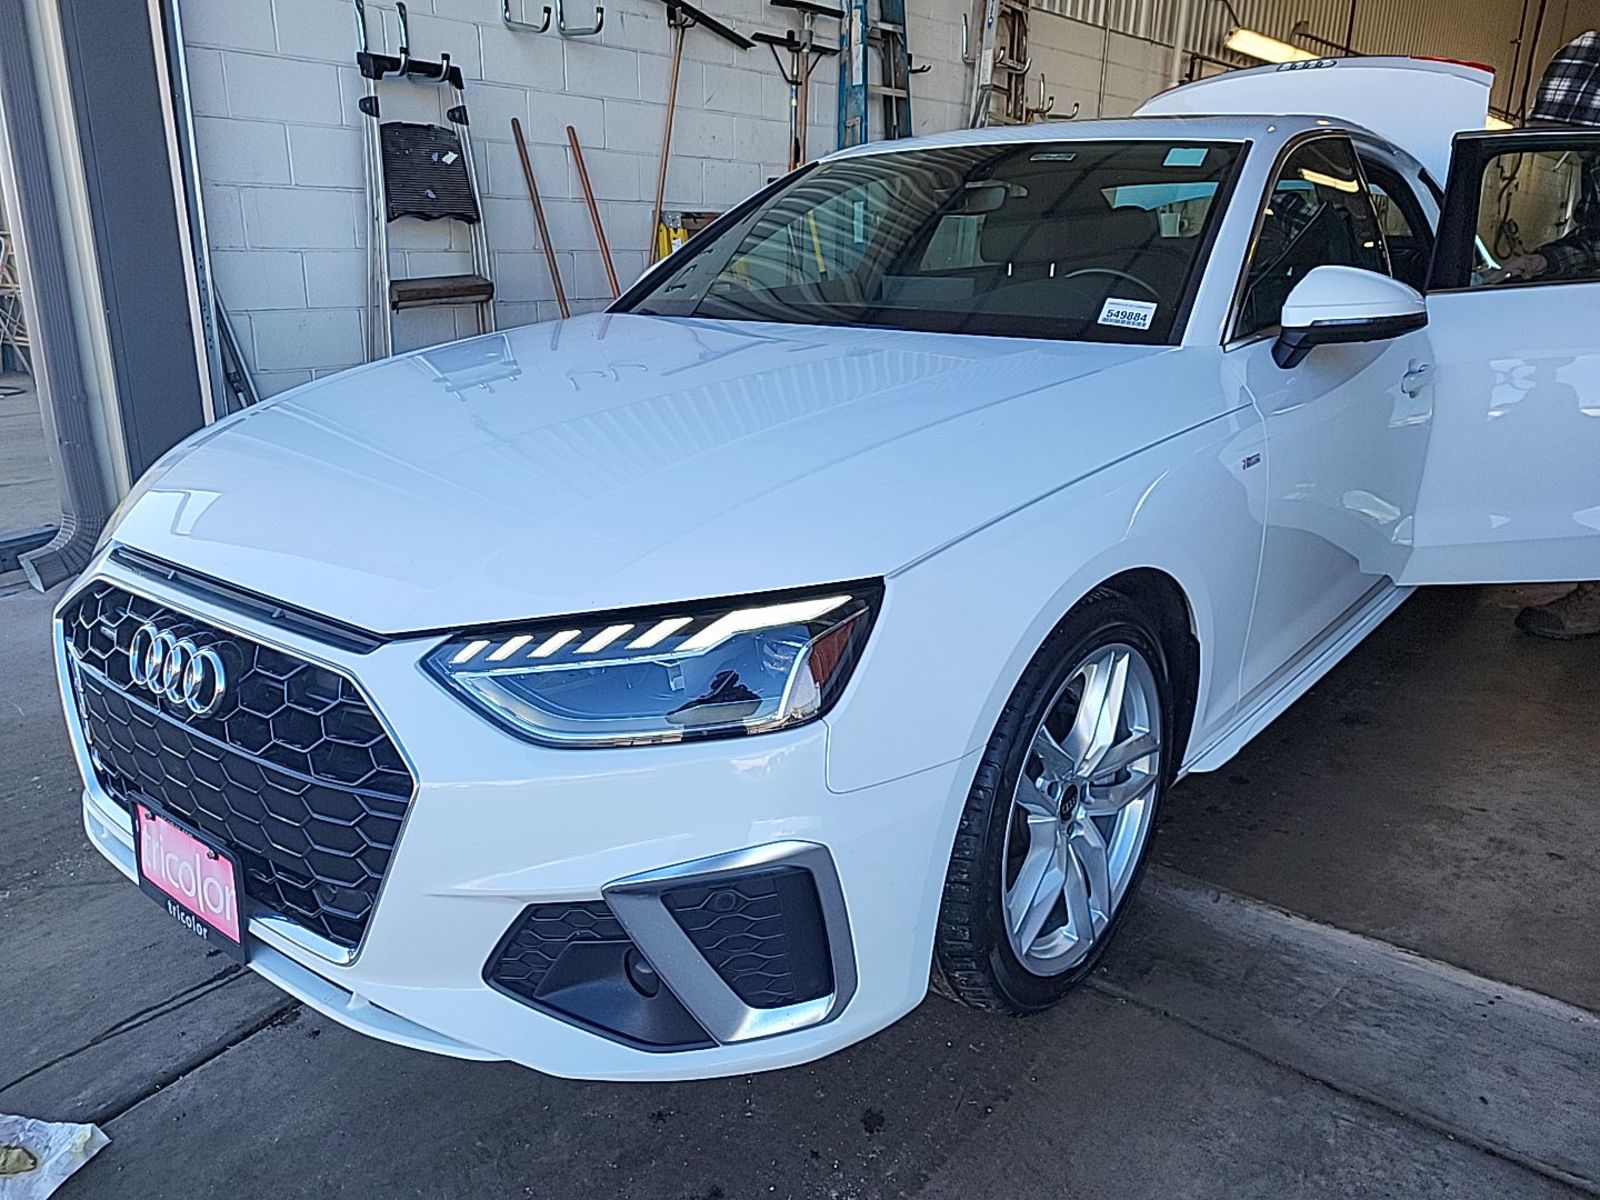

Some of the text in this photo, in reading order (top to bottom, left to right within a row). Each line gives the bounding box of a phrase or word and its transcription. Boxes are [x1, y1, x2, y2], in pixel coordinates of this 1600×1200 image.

[1106, 309, 1148, 322] 549884
[142, 823, 236, 921] tricolor
[167, 899, 208, 939] tricolor
